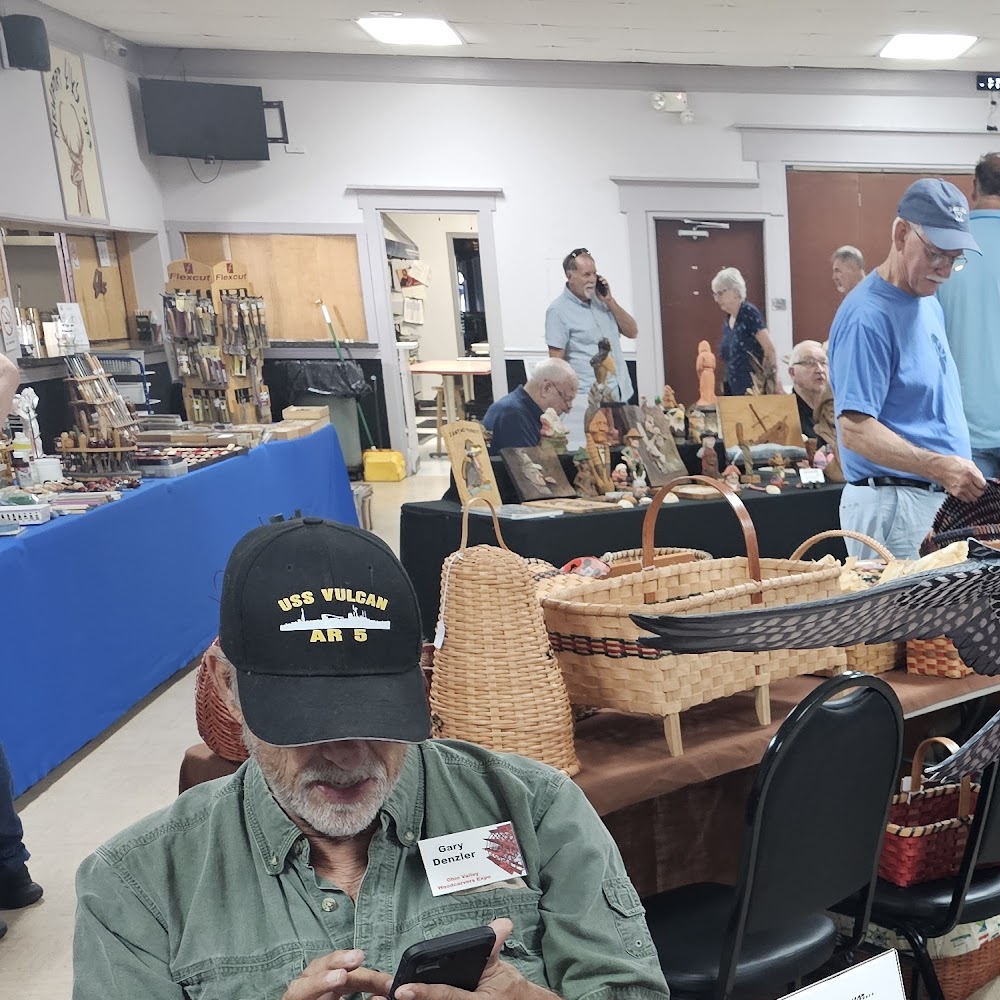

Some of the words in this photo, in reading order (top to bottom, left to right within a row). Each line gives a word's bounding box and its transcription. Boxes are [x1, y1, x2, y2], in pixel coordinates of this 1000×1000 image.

[169, 273, 211, 281] Flexcut
[277, 591, 315, 612] USS
[320, 587, 389, 611] VULCAN
[309, 628, 343, 643] AR
[353, 628, 368, 642] 5
[438, 843, 464, 853] Gary
[432, 851, 476, 866] Denzler
[437, 879, 475, 890] Woodcarvers
